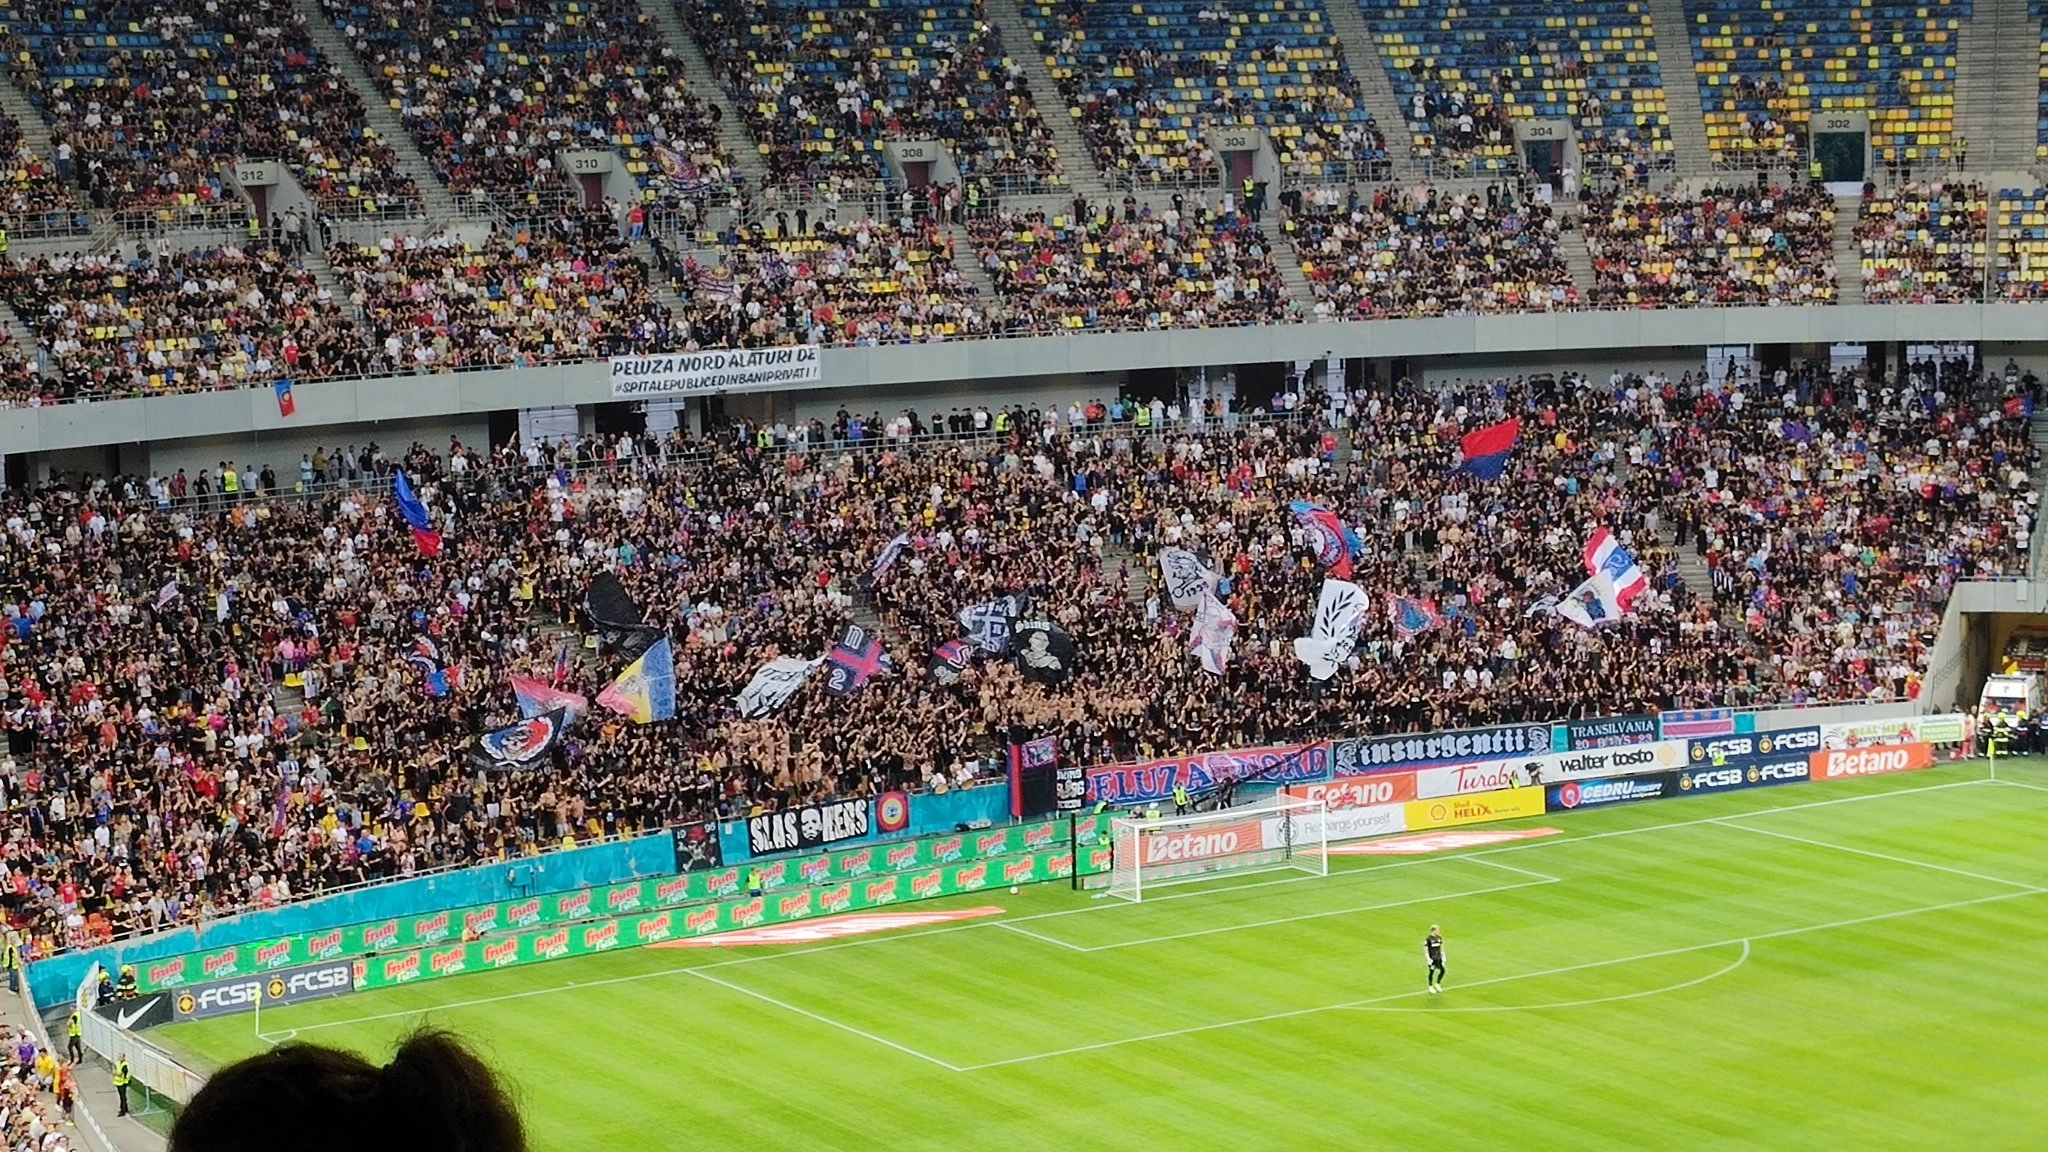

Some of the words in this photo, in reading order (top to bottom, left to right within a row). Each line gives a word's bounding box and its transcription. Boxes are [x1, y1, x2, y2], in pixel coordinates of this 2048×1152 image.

[1530, 127, 1553, 137] 304
[1827, 119, 1850, 129] 302
[576, 159, 598, 169] 310
[901, 148, 923, 158] 308
[241, 171, 264, 181] 312
[612, 357, 673, 376] PELUZA
[678, 357, 725, 373] NORD
[728, 349, 792, 368] ALATURI
[1571, 720, 1654, 738] TRANSILVANIA
[1706, 738, 1752, 758] FCSB
[1773, 731, 1819, 751] FCSB
[1560, 754, 1609, 773] walter
[1612, 748, 1654, 766] tosto
[1826, 749, 1909, 777] Betano
[1087, 762, 1214, 801] ELUZA
[1450, 762, 1512, 792] Turab
[1692, 769, 1743, 789] FCSB
[1760, 761, 1808, 781] FCSB
[1454, 805, 1493, 819] HELIX
[1147, 831, 1238, 863] Betano
[757, 862, 783, 880] rutti
[198, 981, 261, 1009] FCSB
[287, 966, 348, 994] FCSB
